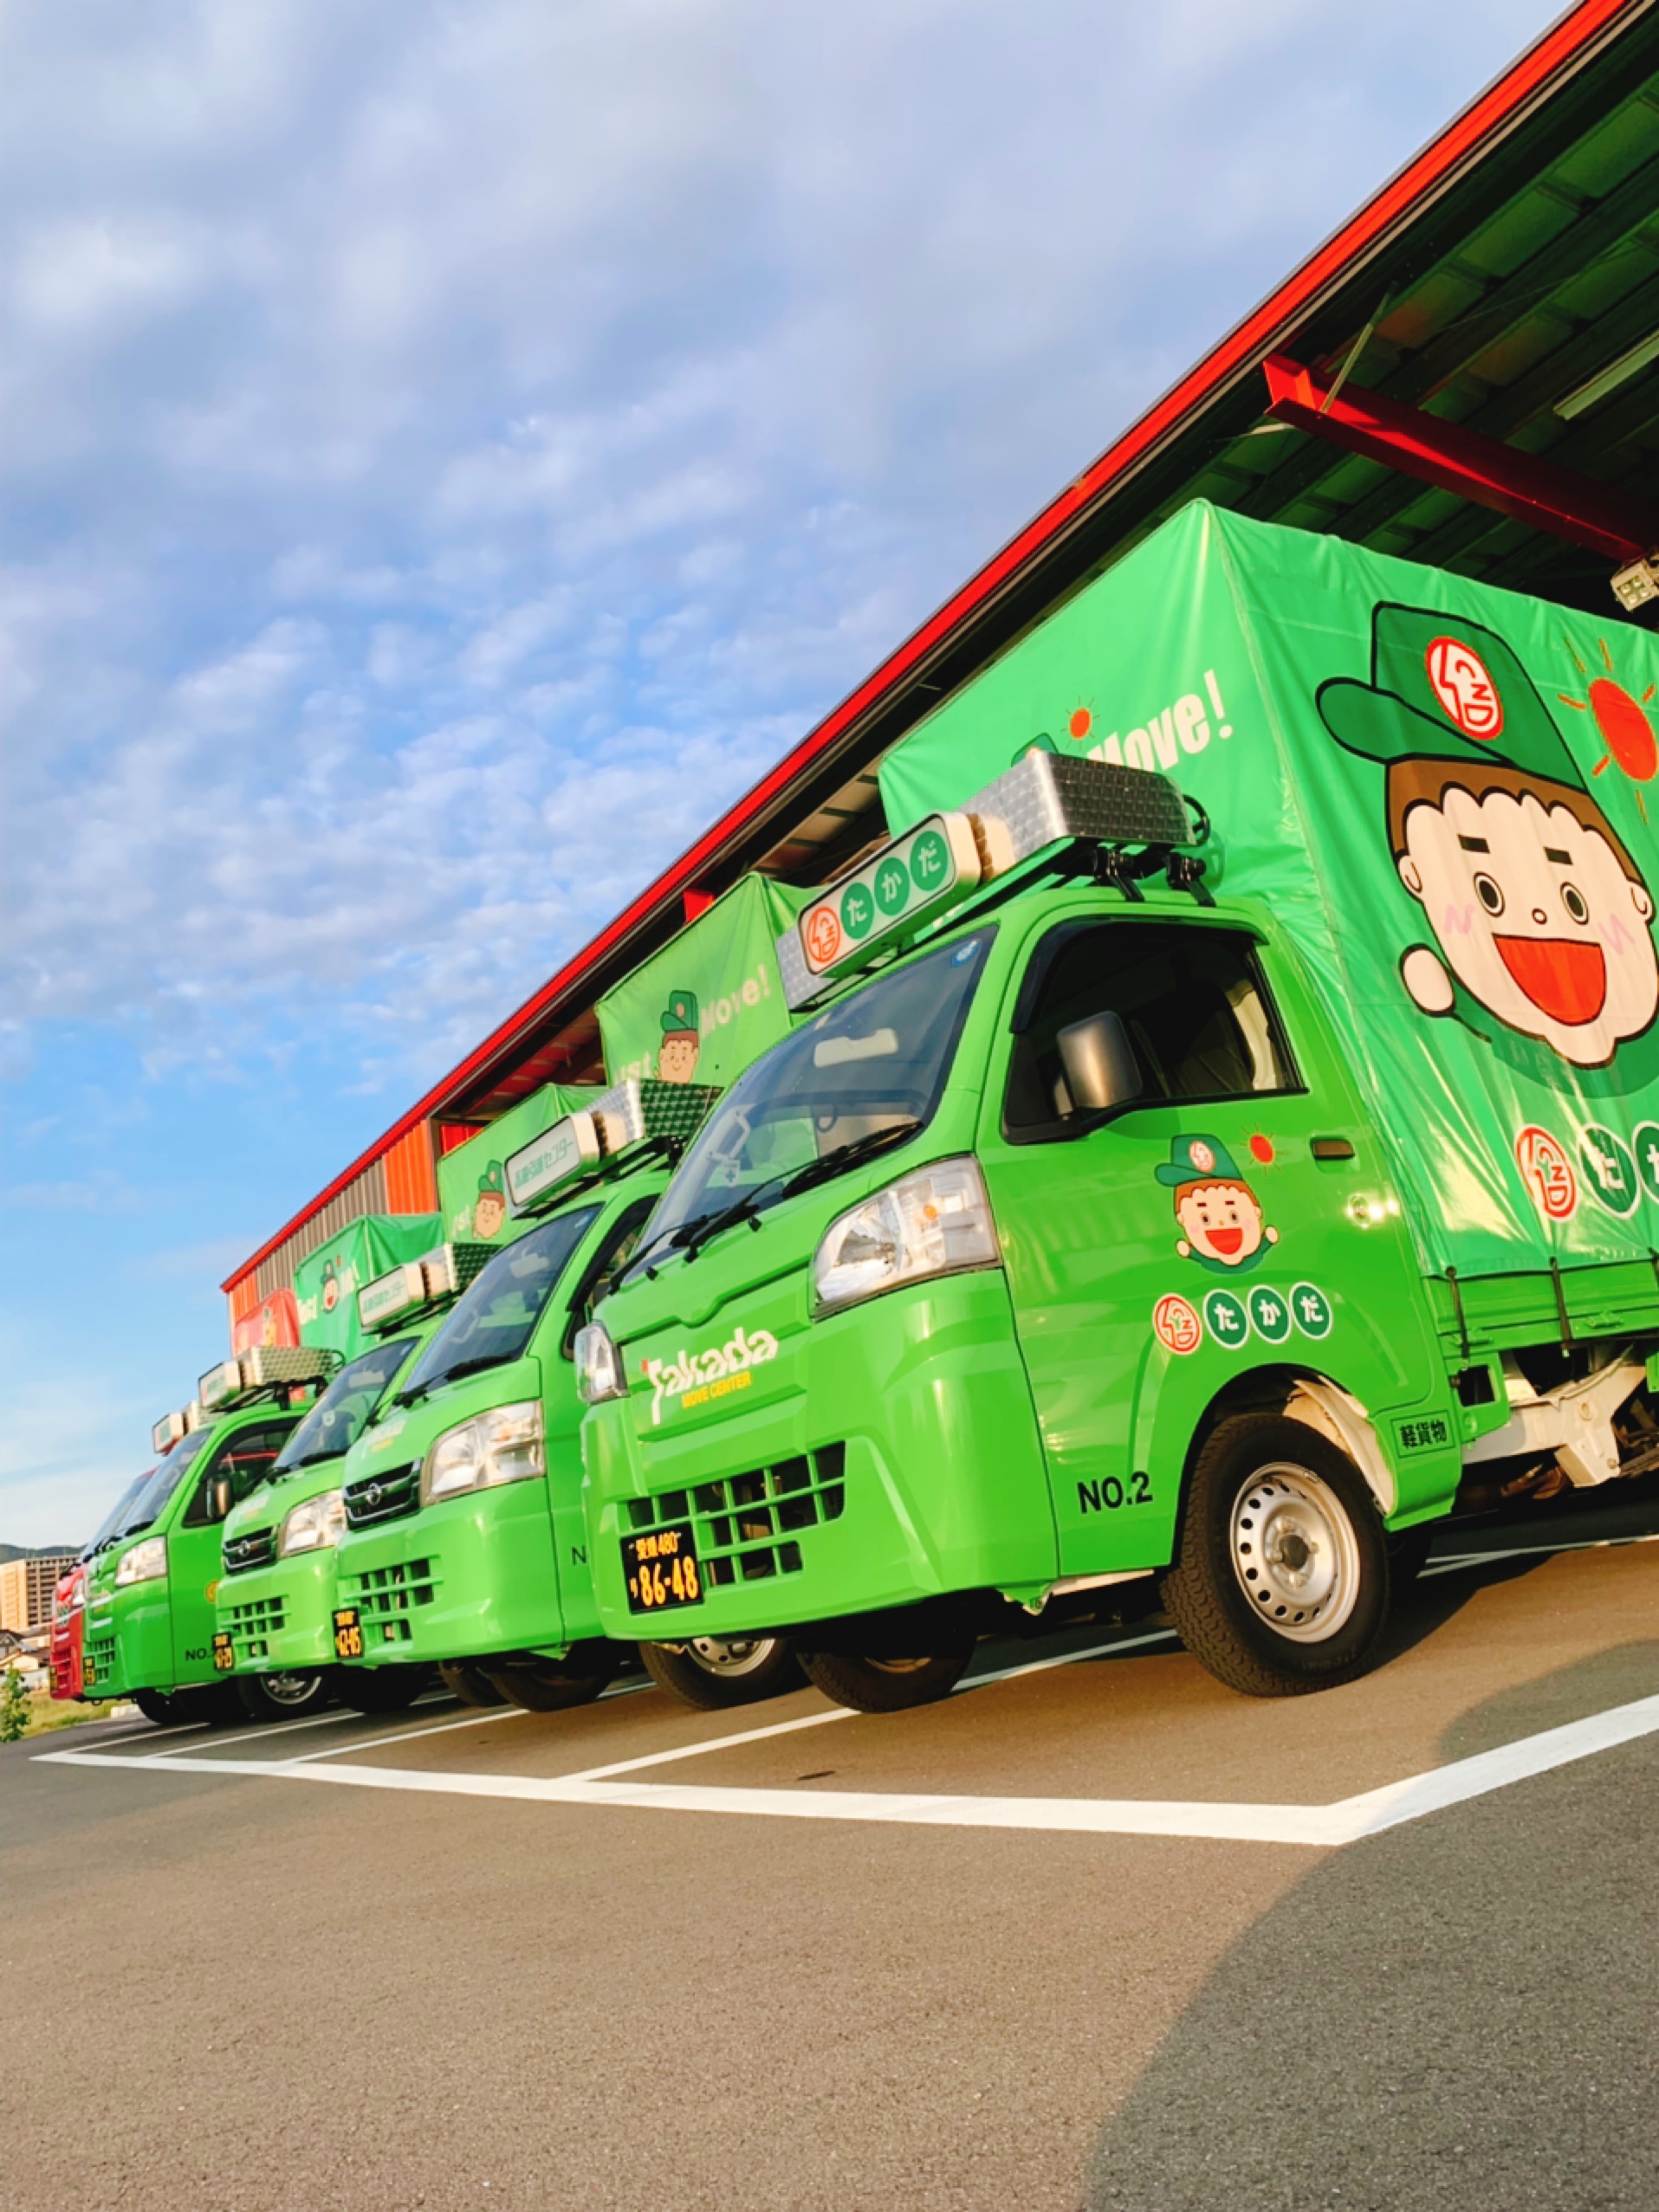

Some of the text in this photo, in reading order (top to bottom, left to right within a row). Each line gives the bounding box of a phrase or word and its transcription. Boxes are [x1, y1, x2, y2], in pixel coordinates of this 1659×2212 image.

[842, 838, 943, 929] たかだ
[1212, 1291, 1326, 1334] たかだ
[642, 1326, 779, 1426] Takada
[681, 1370, 751, 1410] MOVE CENTER
[1400, 1419, 1448, 1450] 軽貨物
[1077, 1471, 1153, 1514] NO.2
[638, 1555, 699, 1607] 86-48
